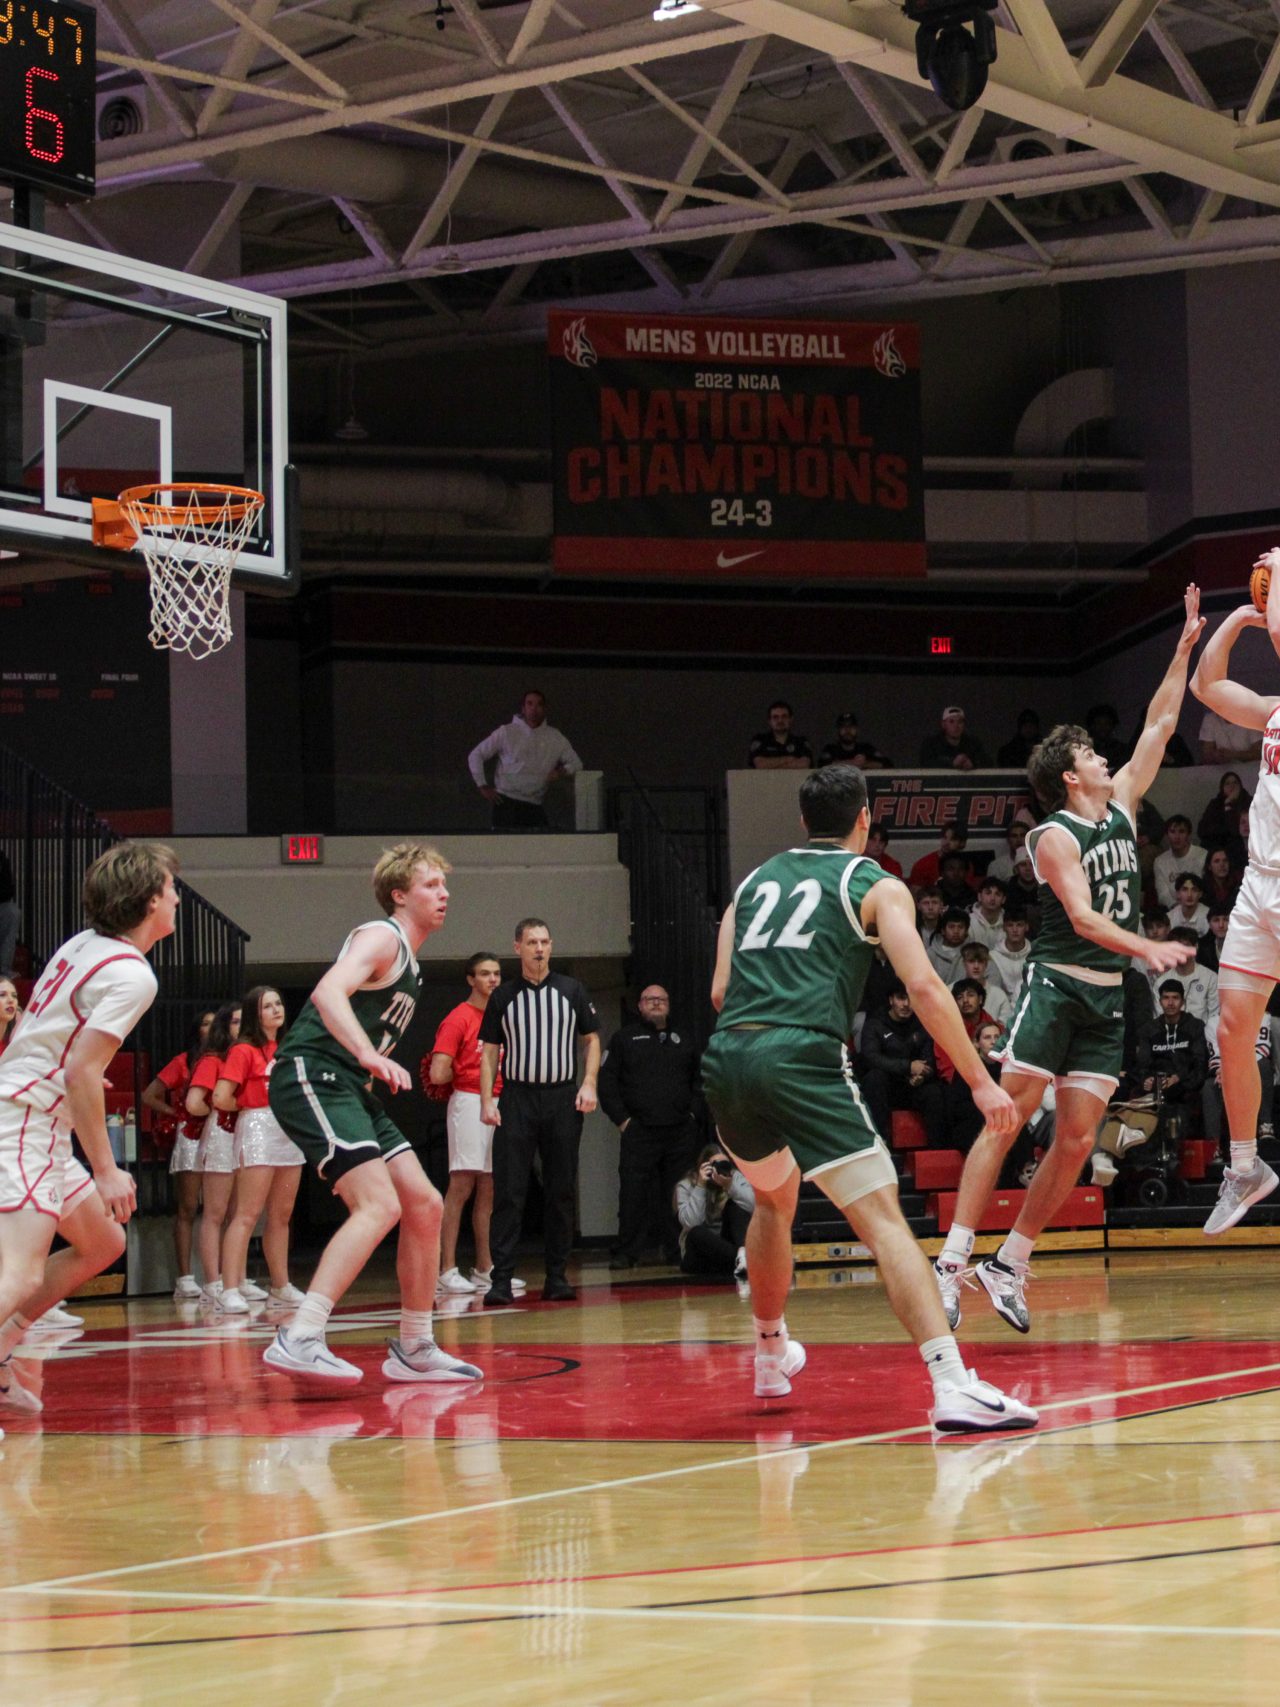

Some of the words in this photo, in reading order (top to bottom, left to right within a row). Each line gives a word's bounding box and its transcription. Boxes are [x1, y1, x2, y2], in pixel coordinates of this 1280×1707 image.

[26, 66, 64, 163] 6
[625, 327, 697, 355] MENS
[705, 330, 846, 360] VOLLEYBALL
[695, 372, 733, 389] 2022
[738, 373, 781, 391] NCAA
[600, 386, 874, 447] NATIONAL
[567, 444, 909, 511] CHAMPIONS
[711, 499, 772, 526] 24-3
[931, 637, 951, 654] EXIT
[891, 780, 923, 792] THE
[872, 796, 961, 826] FIRE
[289, 836, 319, 860] EXIT
[737, 878, 822, 952] 22
[1098, 879, 1132, 921] 25
[29, 957, 75, 1018] 21
